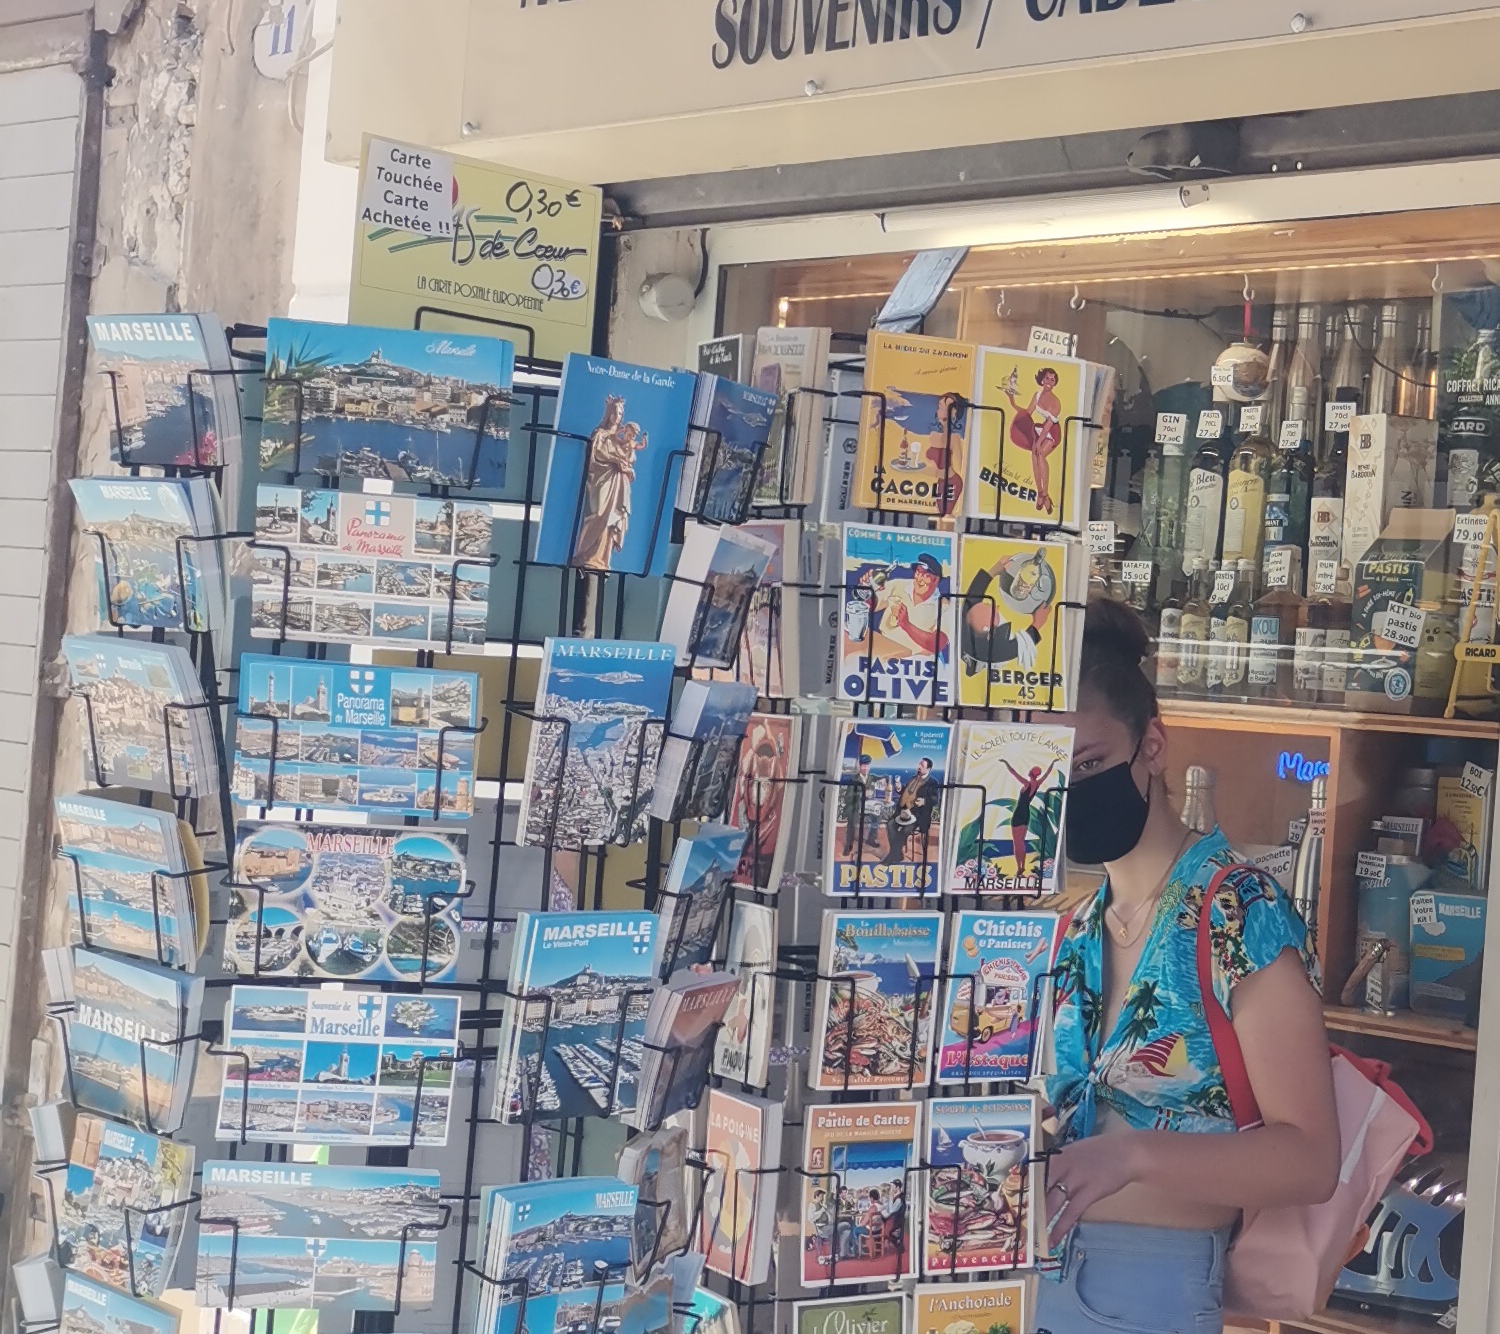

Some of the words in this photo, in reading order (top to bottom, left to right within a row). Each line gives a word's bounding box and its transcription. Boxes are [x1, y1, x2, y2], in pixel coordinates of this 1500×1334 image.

[391, 148, 432, 169] Carte
[377, 167, 443, 193] Touchée
[383, 190, 429, 211] Carte
[362, 208, 432, 233] Achetée
[95, 321, 195, 343] MARSEILLE
[1446, 379, 1481, 394] COFFRET
[1331, 403, 1352, 413] pastis
[1161, 415, 1180, 424] GIN
[979, 466, 1038, 503] BERGER
[1195, 471, 1216, 485] Bleu
[99, 483, 150, 501] MARSEILLE
[871, 476, 956, 501] CAGOLE
[346, 518, 406, 543] Panorama
[848, 528, 882, 540] COMME
[896, 534, 946, 547] MARSEILLE
[1088, 524, 1109, 533] GIN
[1123, 571, 1150, 581] 25.90€
[1215, 571, 1234, 581] pastis
[1368, 562, 1411, 576] PASTIS
[1216, 582, 1231, 591] 10cl
[1389, 603, 1409, 617] KIT
[1408, 610, 1423, 621] bio
[1387, 617, 1418, 633] pastis
[1384, 628, 1416, 646] 28.90€
[555, 644, 675, 662] MARSEILLE
[1464, 647, 1497, 658] RICARD
[858, 656, 935, 678] PASTIS
[990, 669, 1064, 687] BERGER
[844, 674, 949, 703] OLIVE
[1017, 686, 1036, 699] 45
[337, 693, 385, 711] Panorama
[345, 710, 386, 727] Marseille
[1008, 732, 1037, 744] TOUTE
[1469, 766, 1483, 780] BOX
[1461, 776, 1485, 797] 12.50€
[58, 801, 107, 822] MARSEILLE
[306, 831, 396, 855] MARSEILLE
[840, 864, 933, 889] PASTIS
[965, 876, 1043, 890] MARSEILLE
[1411, 897, 1433, 906] Faites
[1413, 906, 1434, 915] Votre
[1417, 915, 1429, 924] Kit
[1438, 903, 1482, 919] MARSEILLE
[544, 920, 653, 942] MARSEILLE
[973, 919, 1043, 938] Chichis
[986, 938, 1033, 950] Panisses
[342, 1001, 352, 1012] de
[79, 1003, 172, 1052] MARSEILLE
[309, 1016, 381, 1038] Marseille
[817, 1115, 854, 1129] Partie
[855, 1115, 870, 1127] de
[873, 1114, 911, 1126] Cartes
[211, 1167, 312, 1186] MARSEILLE
[594, 1190, 636, 1210] MARSEILLE
